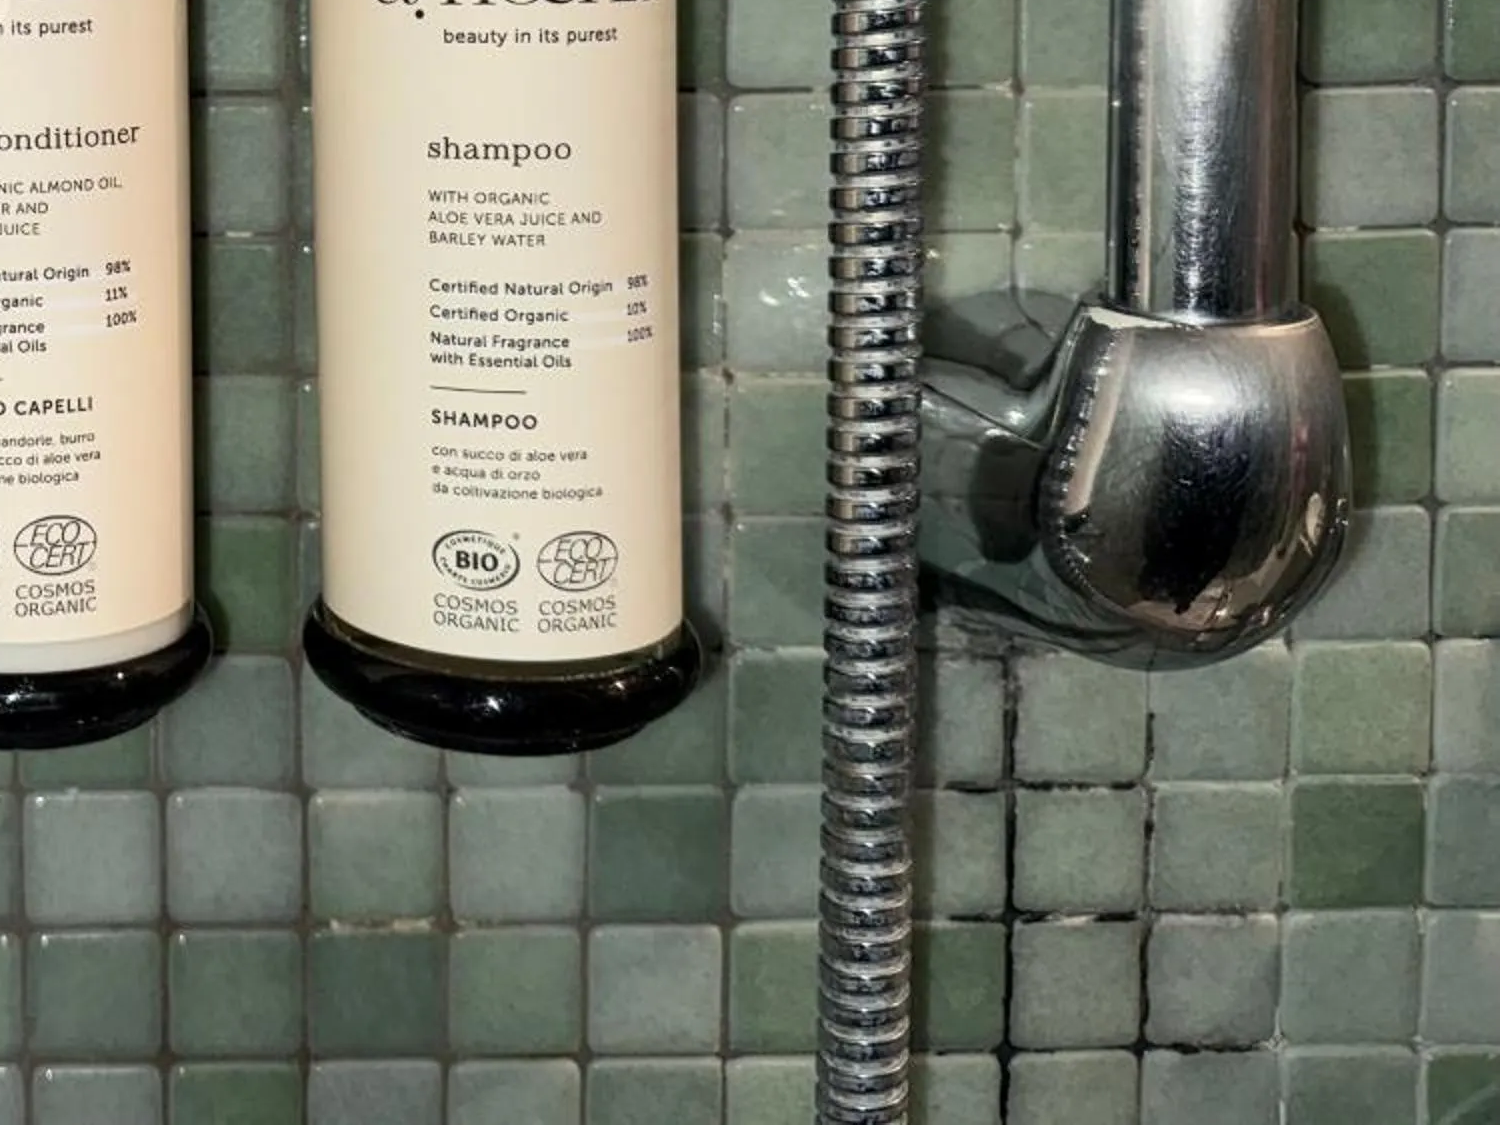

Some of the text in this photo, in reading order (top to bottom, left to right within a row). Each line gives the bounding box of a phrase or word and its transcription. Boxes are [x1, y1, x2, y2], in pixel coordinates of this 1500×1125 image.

[11, 20, 31, 35] its
[39, 18, 93, 38] purest
[443, 27, 618, 47] beauty in its purest
[427, 137, 572, 167] shampoo
[29, 179, 94, 194] ALMOND
[428, 190, 550, 205] WITH ORGANIC
[16, 202, 49, 214] AND
[428, 211, 603, 226] ALOE VERA JUICE AND
[429, 231, 546, 246] BARLEY WATER
[44, 266, 89, 282] Origin
[105, 260, 131, 276] 98%
[105, 286, 128, 302] 11%
[429, 274, 648, 297] Certified Natural Origin 98%
[105, 310, 137, 327] 100%
[429, 300, 647, 325] Certified Organic 10%
[18, 340, 47, 353] Oils
[430, 326, 652, 351] Natural Fragrance 100%
[430, 352, 572, 368] with Essential Oils
[14, 396, 93, 415] CAPELLI
[431, 409, 537, 430] SHAMPOO
[60, 432, 95, 444] burro
[26, 454, 38, 465] di
[43, 453, 71, 464] aloe
[75, 450, 100, 462] vera
[432, 445, 587, 462] con succo di aloe vera
[18, 470, 79, 485] biologica
[444, 467, 487, 479] acqua
[491, 468, 503, 479] di
[508, 470, 540, 481] orzo
[432, 483, 603, 501] da coltivazione biologica
[31, 521, 81, 545] ECO
[30, 542, 88, 568] CERT
[555, 537, 604, 561] ECO
[456, 550, 498, 571] BIO
[554, 559, 610, 584] CERT
[15, 579, 95, 600] COSMOS
[15, 597, 97, 617] ORGANIC
[434, 594, 518, 615] COSMOS
[538, 596, 616, 616] COSMOS
[433, 612, 520, 633] ORGANIC
[538, 613, 617, 634] ORGANIC
